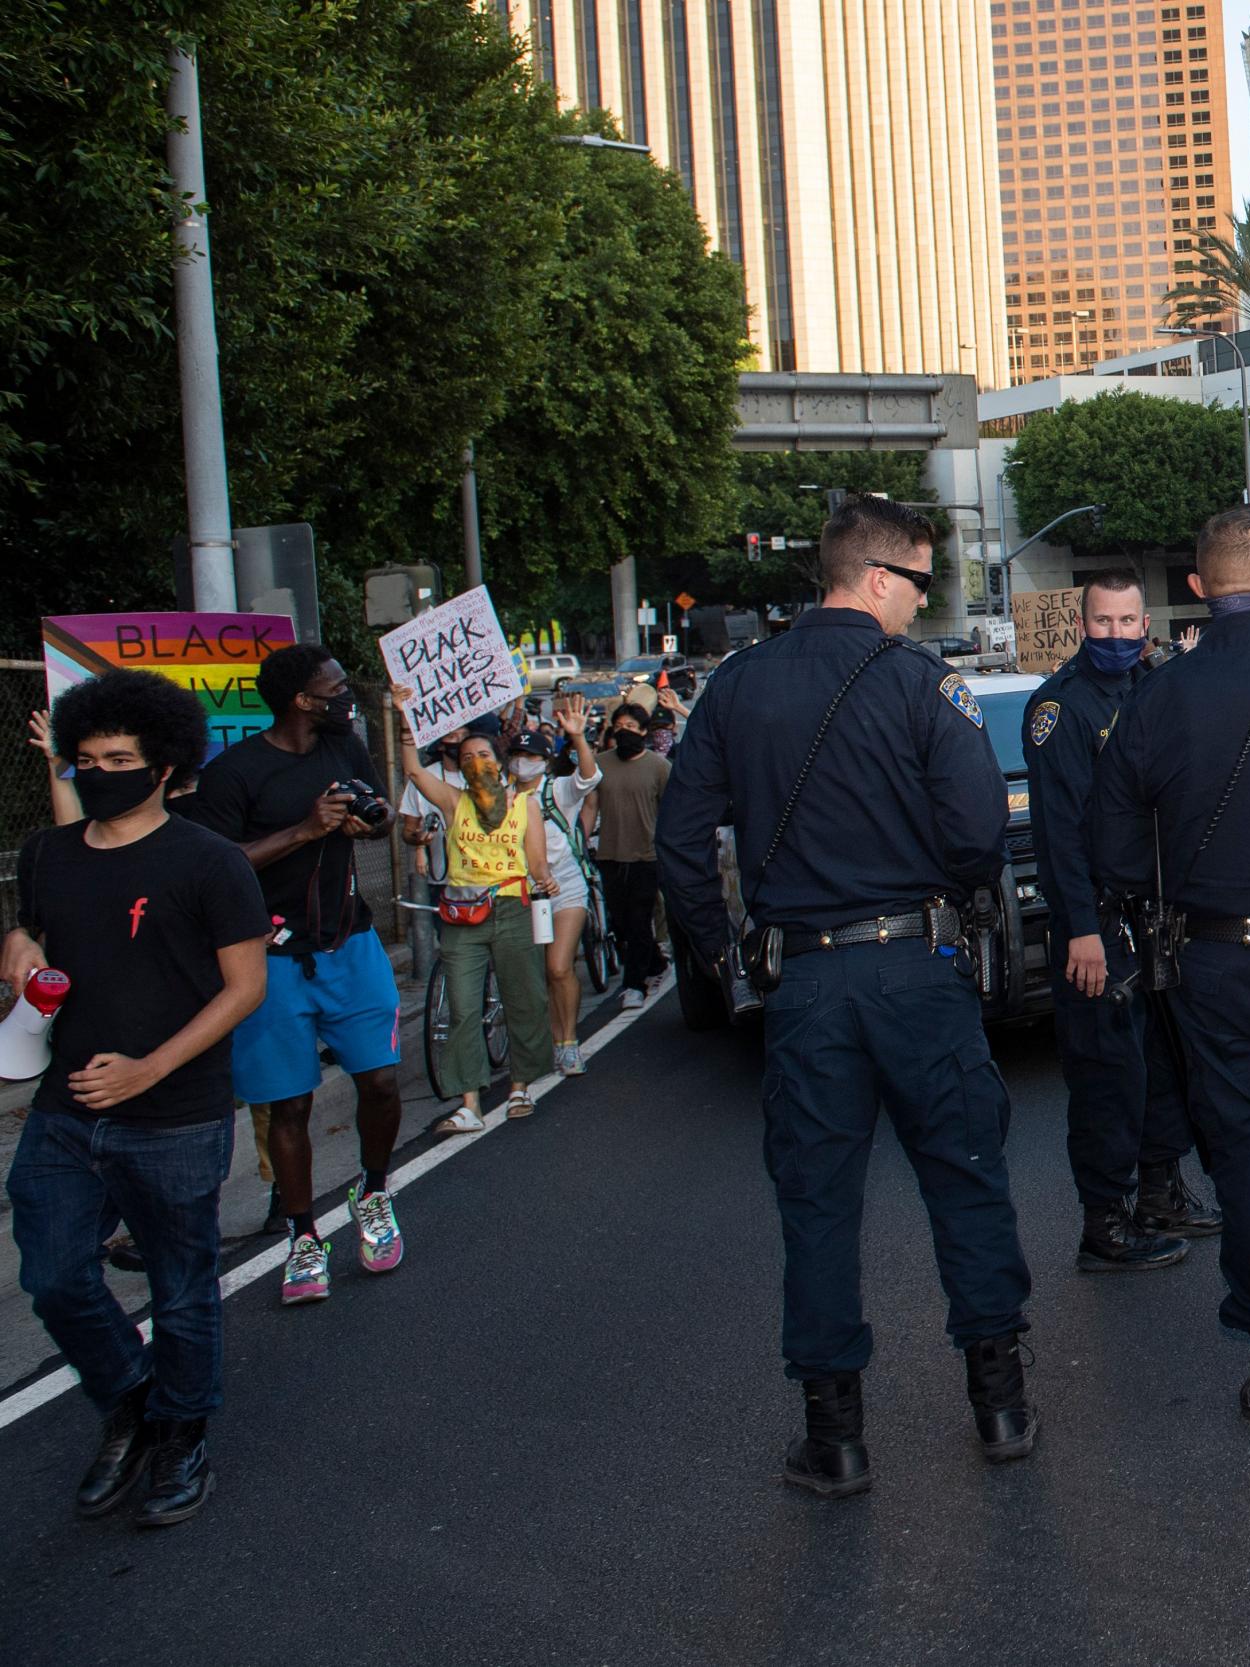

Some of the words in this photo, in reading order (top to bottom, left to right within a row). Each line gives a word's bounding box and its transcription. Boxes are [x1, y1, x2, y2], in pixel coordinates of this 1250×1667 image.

[1014, 599, 1032, 613] WE
[1036, 591, 1072, 611] SEE
[1016, 617, 1032, 630] WE
[1034, 608, 1077, 629] HEAR
[116, 624, 274, 659] BLACK
[400, 617, 486, 673] BLACK
[1033, 628, 1077, 649] STAN
[1020, 651, 1043, 662] WITH
[416, 650, 494, 698] LIVES
[190, 677, 261, 709] IVE
[412, 671, 509, 732] MATTER
[462, 818, 518, 830] KW
[458, 831, 518, 844] JUSTICE
[461, 859, 515, 871] PEACE
